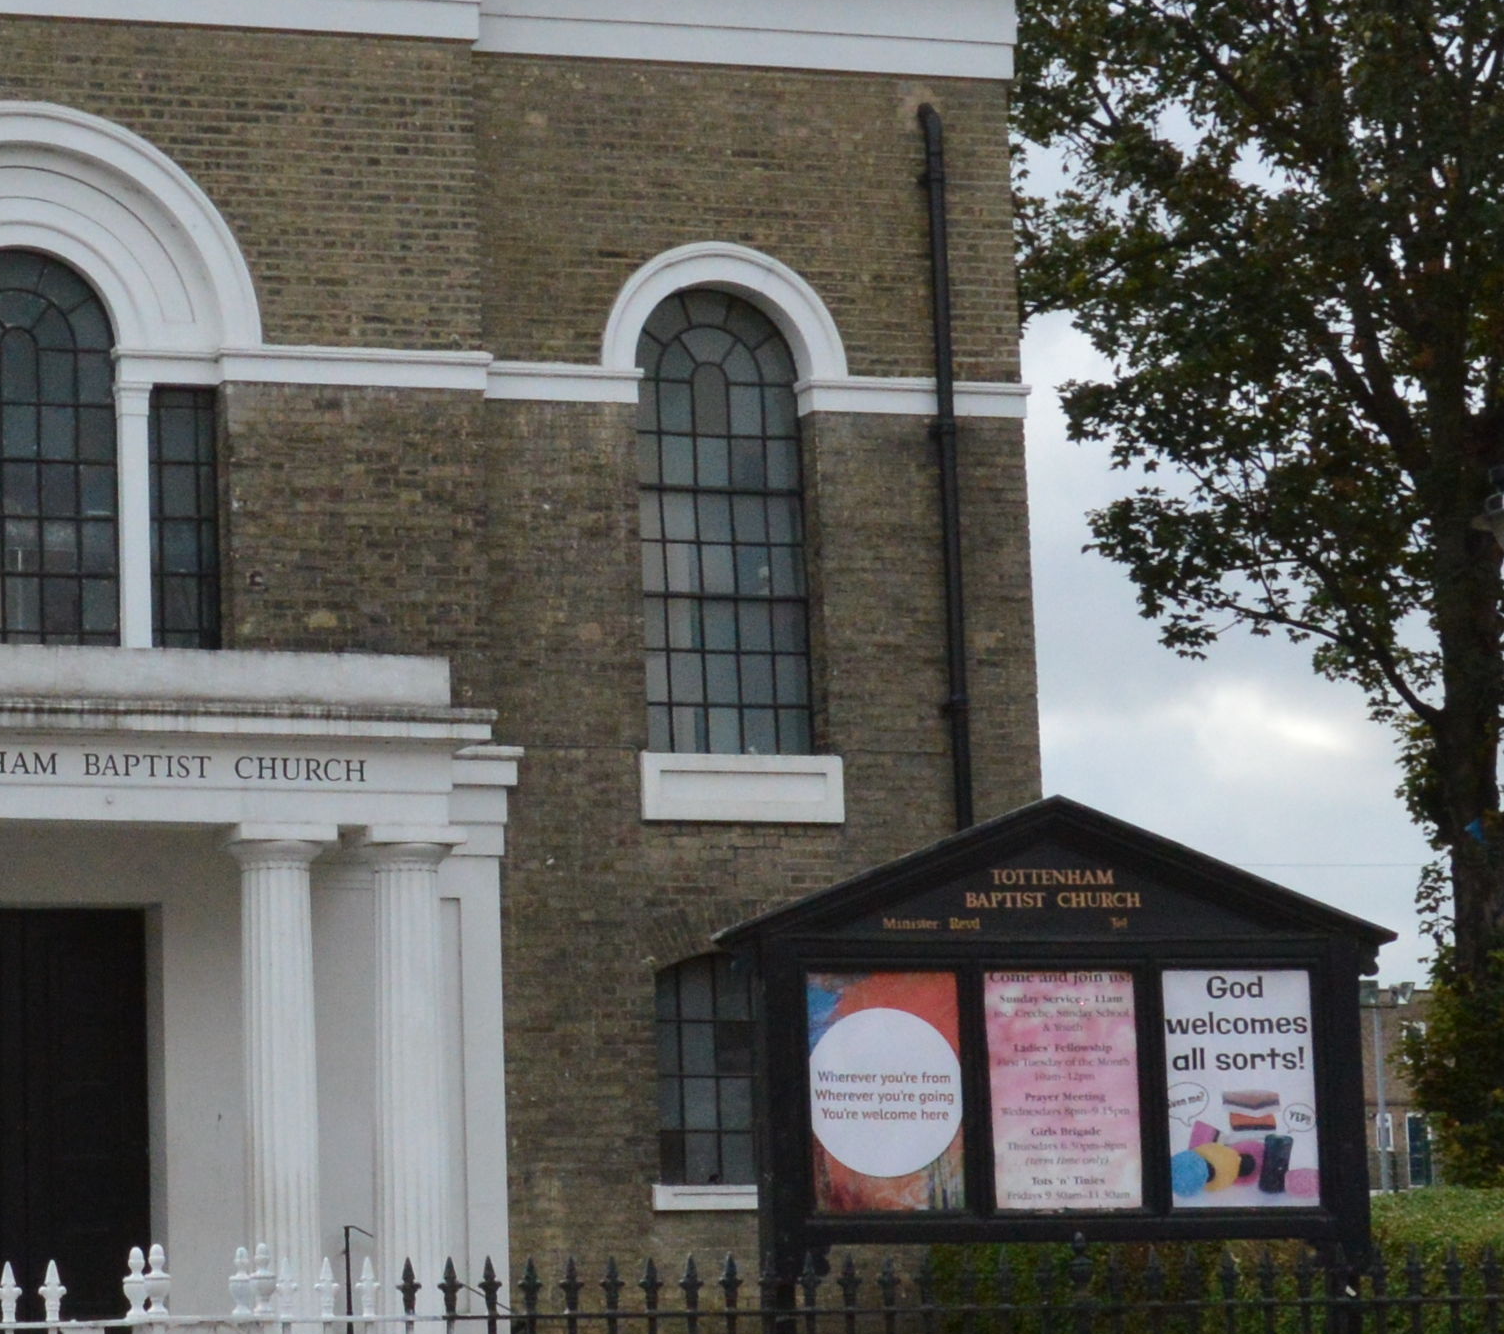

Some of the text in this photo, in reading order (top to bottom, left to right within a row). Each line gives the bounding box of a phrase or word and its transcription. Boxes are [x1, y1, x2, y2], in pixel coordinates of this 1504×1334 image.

[82, 752, 212, 779] BAPTIST
[234, 755, 368, 783] CHURCH
[990, 869, 1114, 885] TOTTENHAM
[965, 892, 1141, 908] BAPTIST CHURCH
[949, 918, 981, 930] Revd
[988, 971, 1035, 983] Come
[1039, 971, 1068, 983] and
[1073, 971, 1103, 986] join
[1206, 975, 1264, 999] God
[999, 994, 1039, 1005] Sunday
[1042, 994, 1082, 1004] Service
[1094, 994, 1124, 1004] 11am
[1165, 1011, 1308, 1035] welcomes
[1054, 1043, 1113, 1054] Fellowship
[1097, 1057, 1131, 1067] Month
[1172, 1046, 1305, 1071] all sorts!
[817, 1071, 951, 1086] Wherever you're from
[814, 1089, 955, 1105] Wherever you're going
[1024, 1092, 1107, 1104] Prayer Meeting
[821, 1107, 950, 1121] You're welcome here
[1031, 1126, 1102, 1138] Girls Brigade
[1031, 1176, 1054, 1186] Tots
